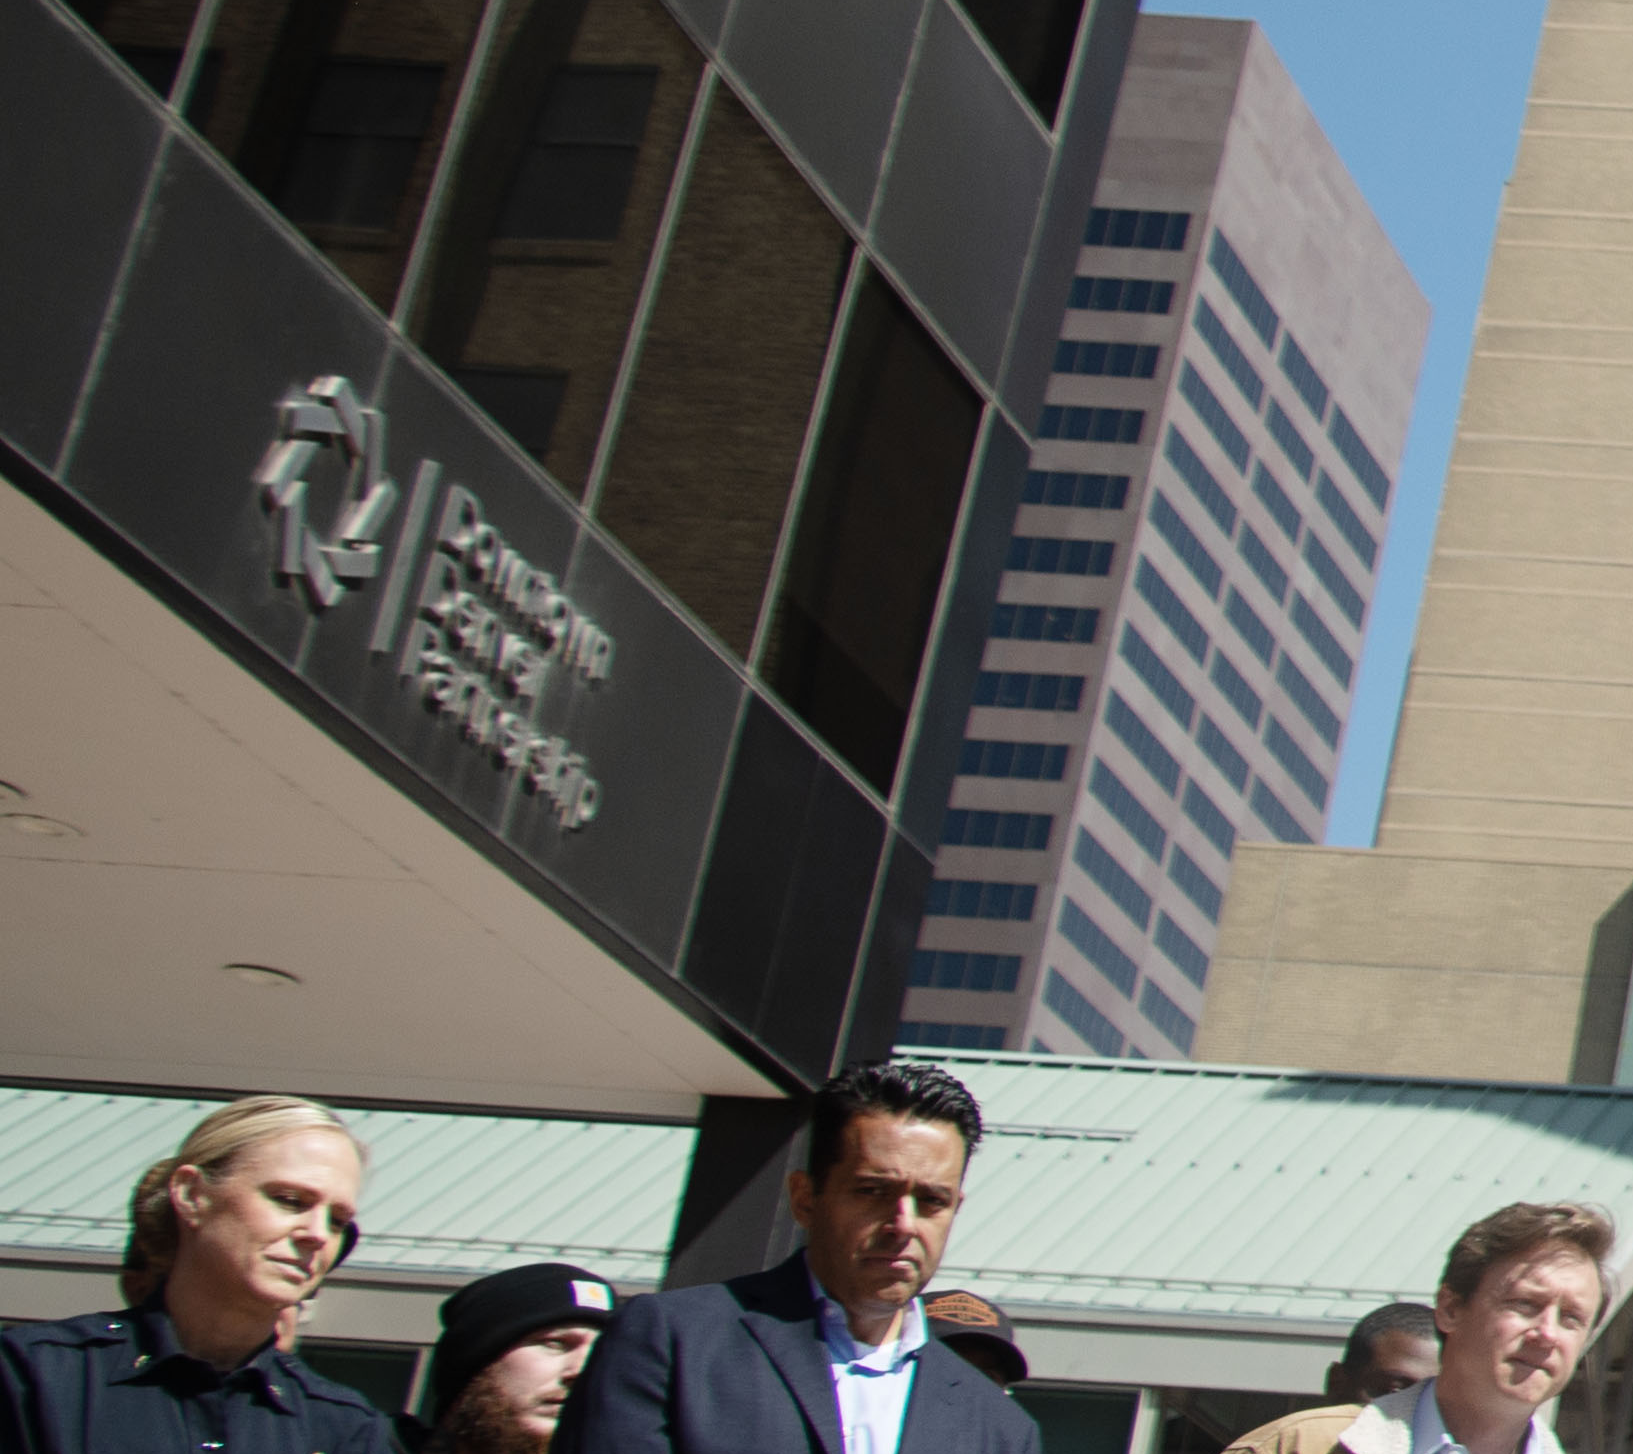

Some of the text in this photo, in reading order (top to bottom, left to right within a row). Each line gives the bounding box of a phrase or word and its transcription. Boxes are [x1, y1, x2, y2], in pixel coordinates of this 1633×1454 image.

[419, 552, 550, 697] Denver
[436, 485, 614, 681] Downtown
[400, 621, 601, 828] Partnership
